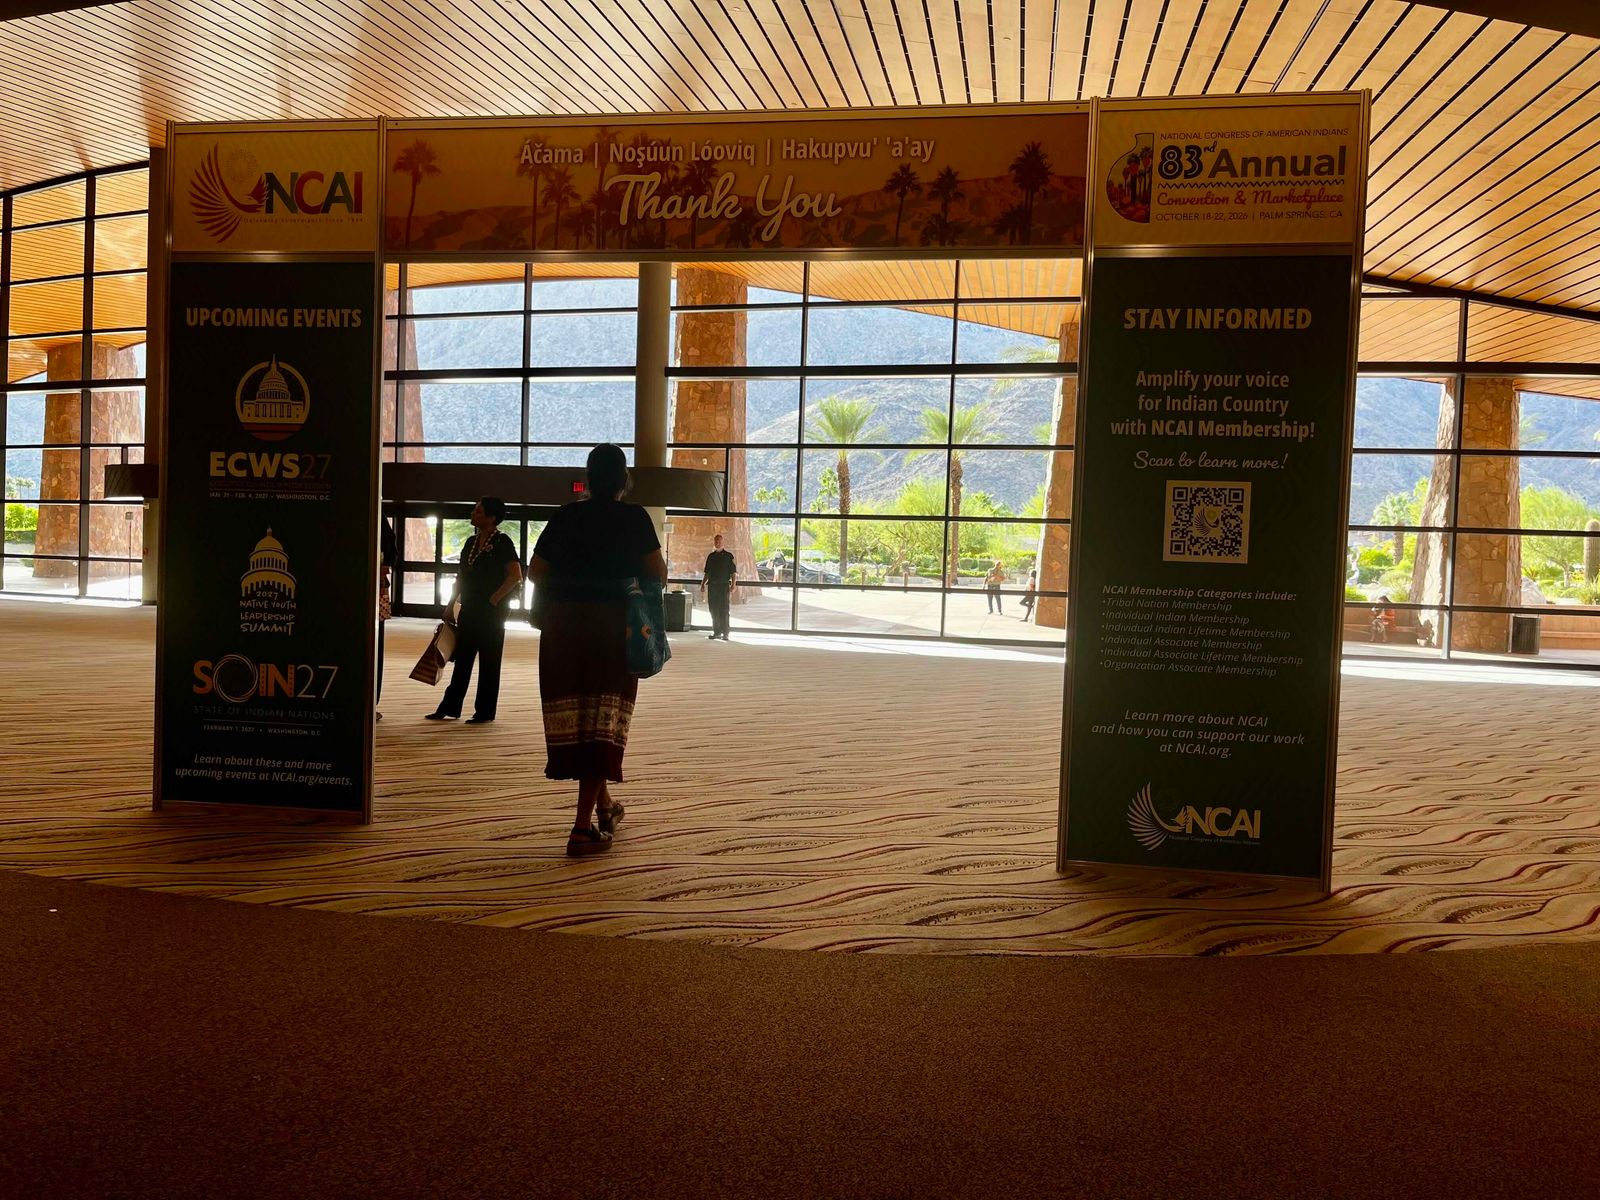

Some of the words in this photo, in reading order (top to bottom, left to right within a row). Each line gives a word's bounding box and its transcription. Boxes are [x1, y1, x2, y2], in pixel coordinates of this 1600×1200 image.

[1204, 130, 1250, 139] CONGRESS
[1266, 129, 1311, 137] AMERICAN
[1313, 128, 1349, 136] INDIANS
[691, 139, 756, 166] Lóoviq
[782, 137, 878, 165] Hakupvu'
[1208, 145, 1347, 178] Annual
[264, 170, 364, 215] NCAI
[1157, 190, 1229, 206] Convention
[1234, 190, 1246, 205] &
[1252, 187, 1344, 210] Marketplace
[604, 172, 742, 226] Thank
[756, 174, 842, 242] You
[1156, 212, 1199, 221] OCTOBER
[1228, 211, 1248, 220] 2026
[1260, 211, 1283, 219] PALM
[186, 308, 288, 327] UPCOMING
[294, 308, 362, 328] EVENTS
[1123, 308, 1185, 329] STAY
[1186, 308, 1312, 330] INFORMED
[1136, 370, 1200, 391] Amplify
[1203, 374, 1242, 391] your
[1246, 371, 1290, 388] voice
[1138, 394, 1162, 411] for
[1166, 395, 1217, 412] Indian
[1222, 396, 1289, 417] Country
[1111, 419, 1146, 435] with
[1152, 420, 1193, 436] NCAI
[1198, 420, 1315, 442] Membership!
[1133, 450, 1175, 469] Scan
[1179, 452, 1194, 467] to
[1198, 451, 1238, 468] learn
[1242, 453, 1288, 469] more!
[256, 591, 278, 600] 2027
[1102, 585, 1128, 594] NCAI
[1130, 586, 1194, 599] Membership
[1197, 588, 1252, 600] Categories
[1255, 590, 1297, 600] include:
[240, 600, 268, 608] NATIVE
[271, 600, 296, 609] YOUTH
[1136, 600, 1168, 609] Nation
[1172, 600, 1232, 612] Membership
[240, 612, 295, 621] LEADERSHIP
[1155, 612, 1186, 622] Indian
[1188, 614, 1250, 625] Membership
[240, 622, 294, 636] SUMMIT
[1154, 624, 1186, 634] Indian
[1188, 626, 1227, 636] Lifetime
[1230, 628, 1290, 640] Membership
[1154, 637, 1199, 647] Associate
[1201, 639, 1262, 651] Membership
[1153, 649, 1199, 660] Associate
[1201, 651, 1240, 662] Lifetime
[1242, 654, 1304, 666] Membership
[1168, 662, 1213, 673] Associate
[1215, 664, 1277, 677] Membership
[246, 708, 284, 718] INDIAN
[288, 710, 335, 720] NATIONS
[1125, 709, 1159, 721] Learn
[1163, 713, 1195, 724] more
[1198, 714, 1234, 726] about
[1238, 716, 1268, 727] NCAI
[1091, 723, 1114, 734] and
[1118, 724, 1144, 736] how
[1145, 728, 1168, 739] you
[1172, 729, 1194, 738] can
[1197, 730, 1245, 743] support
[1249, 733, 1269, 742] our
[1273, 733, 1305, 745] work
[1160, 742, 1172, 752] at
[1176, 743, 1232, 759] NCAI.org.
[194, 753, 222, 764] Learn
[224, 755, 253, 766] about
[256, 757, 282, 768] these
[285, 760, 303, 769] and
[306, 762, 332, 771] more
[175, 767, 222, 780] upcoming
[225, 770, 256, 780] events
[259, 772, 269, 781] at
[272, 771, 353, 786] NCAI.org/events.
[1186, 805, 1261, 839] NCAI
